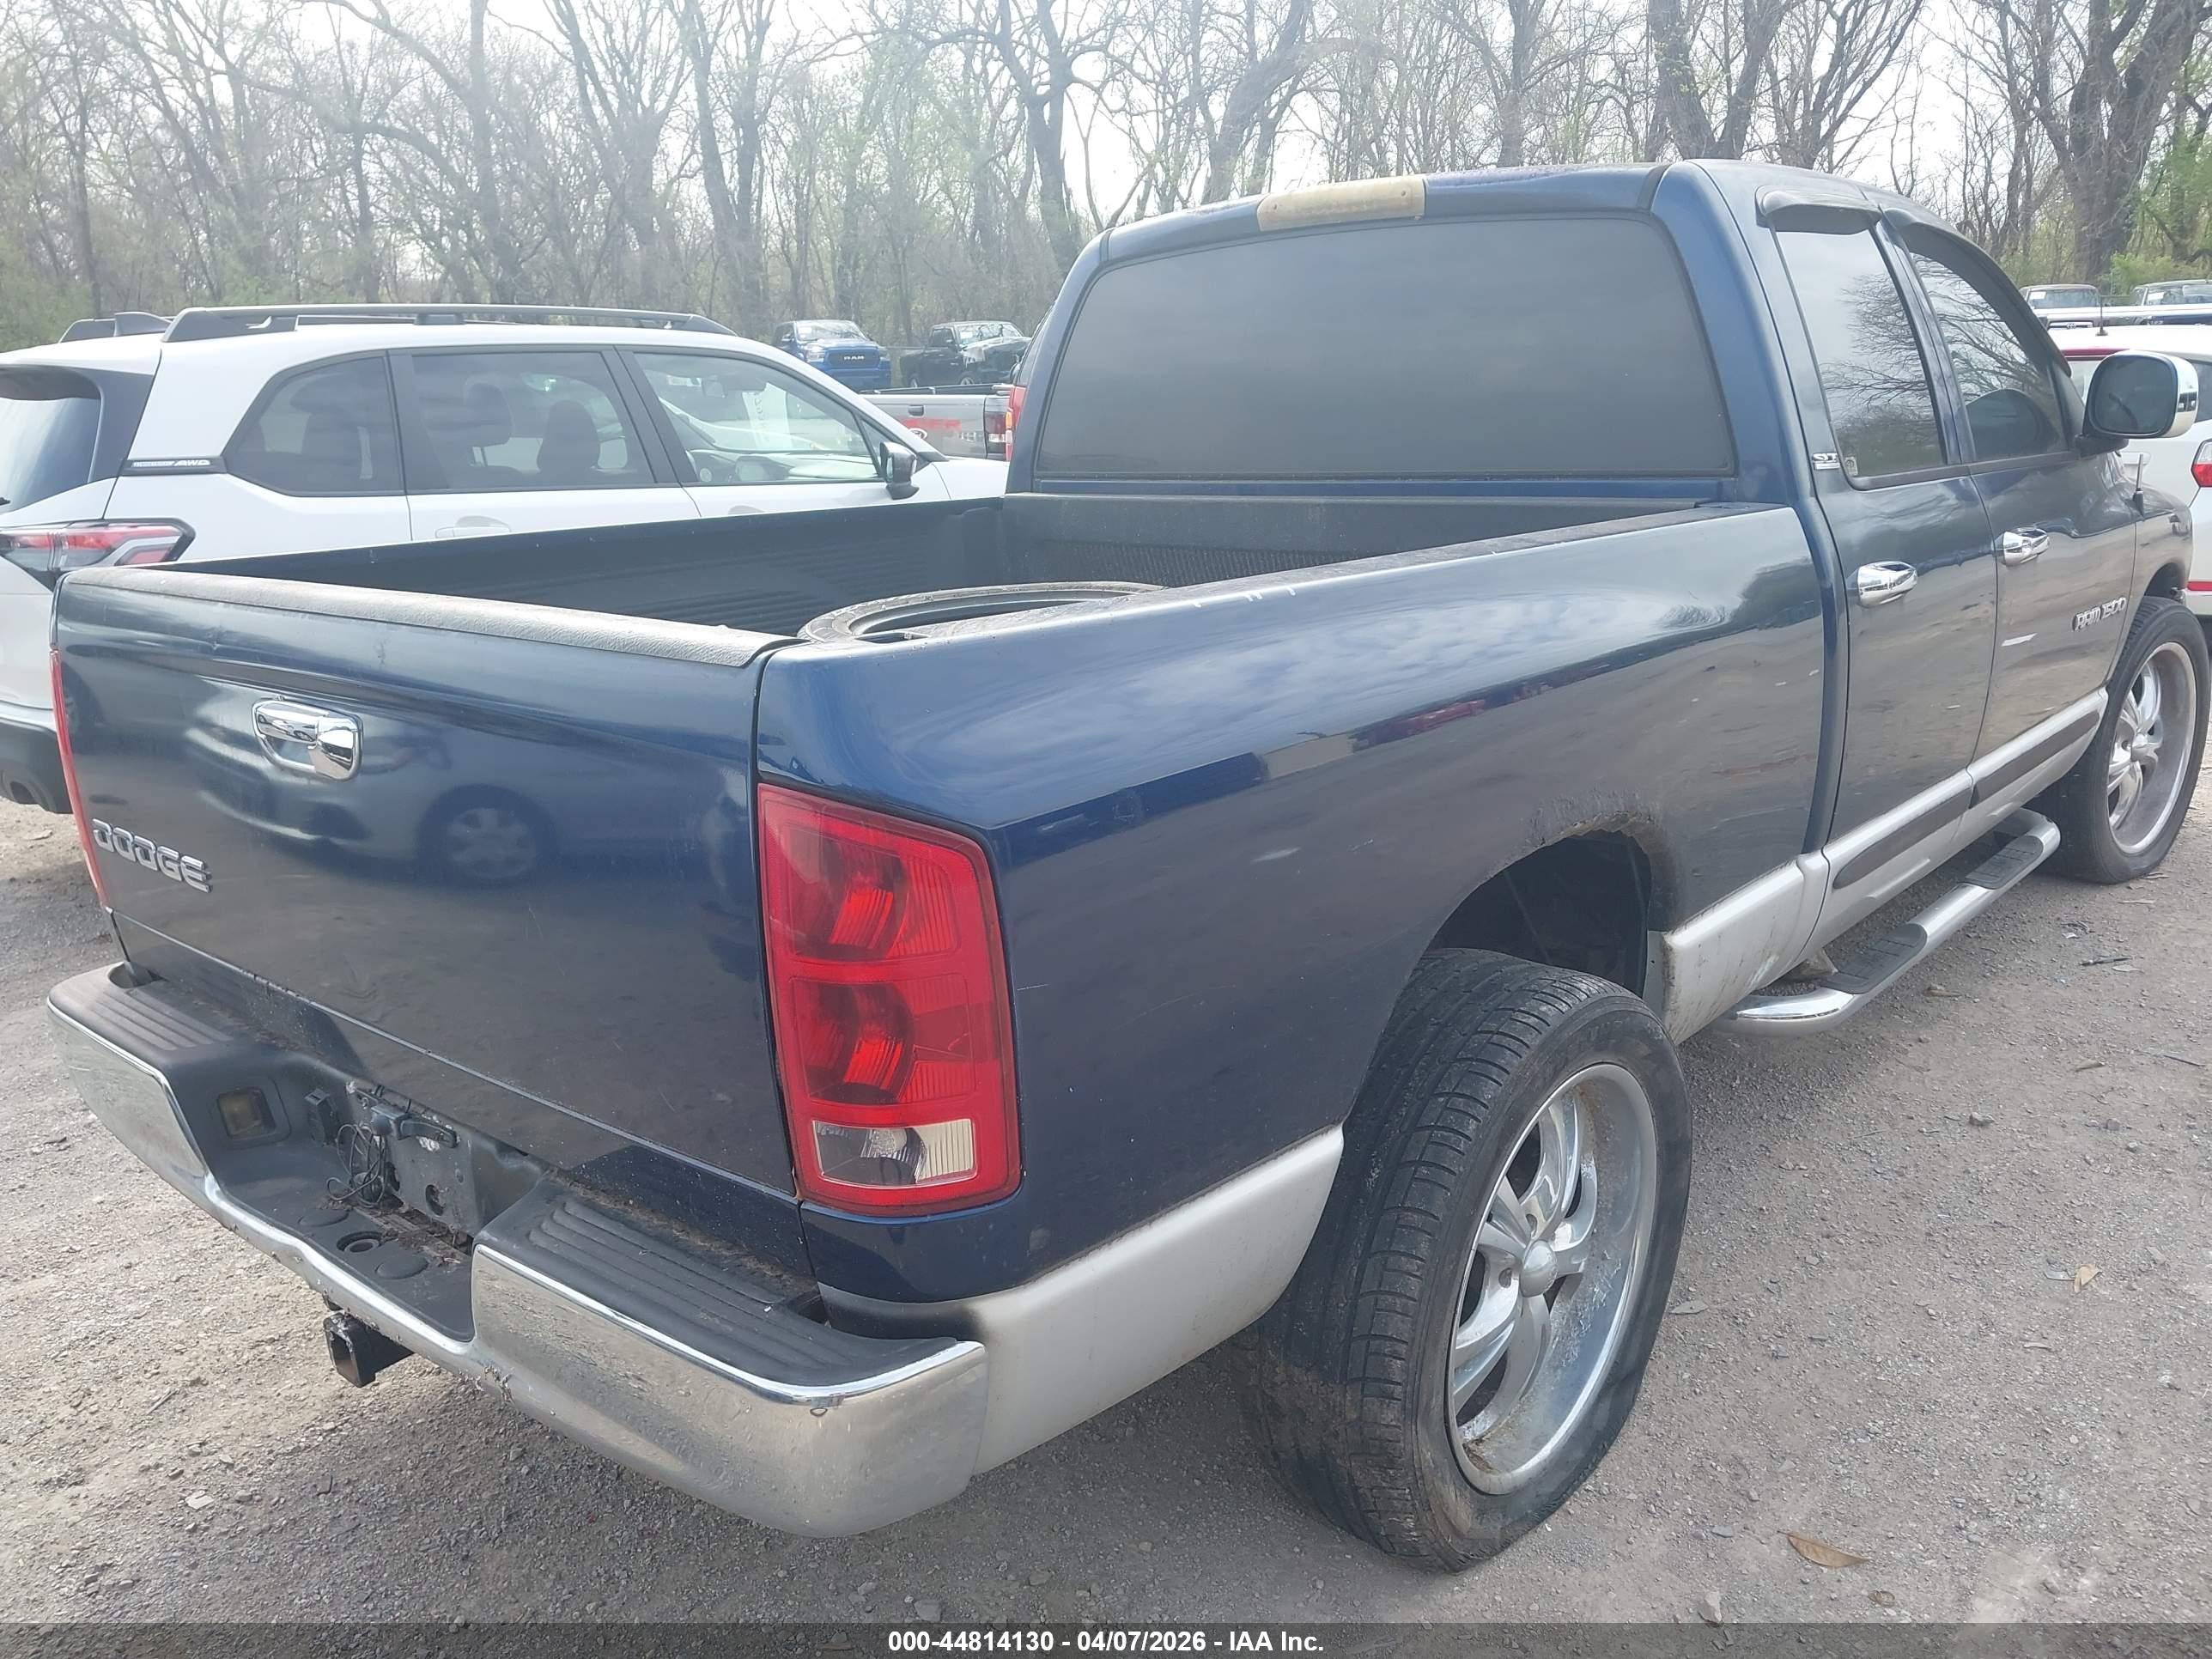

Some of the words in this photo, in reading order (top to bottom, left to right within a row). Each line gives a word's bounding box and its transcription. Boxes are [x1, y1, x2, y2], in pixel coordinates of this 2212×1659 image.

[2074, 606, 2101, 631] RAM
[2101, 597, 2127, 618] 1500
[92, 817, 212, 893] DODGE
